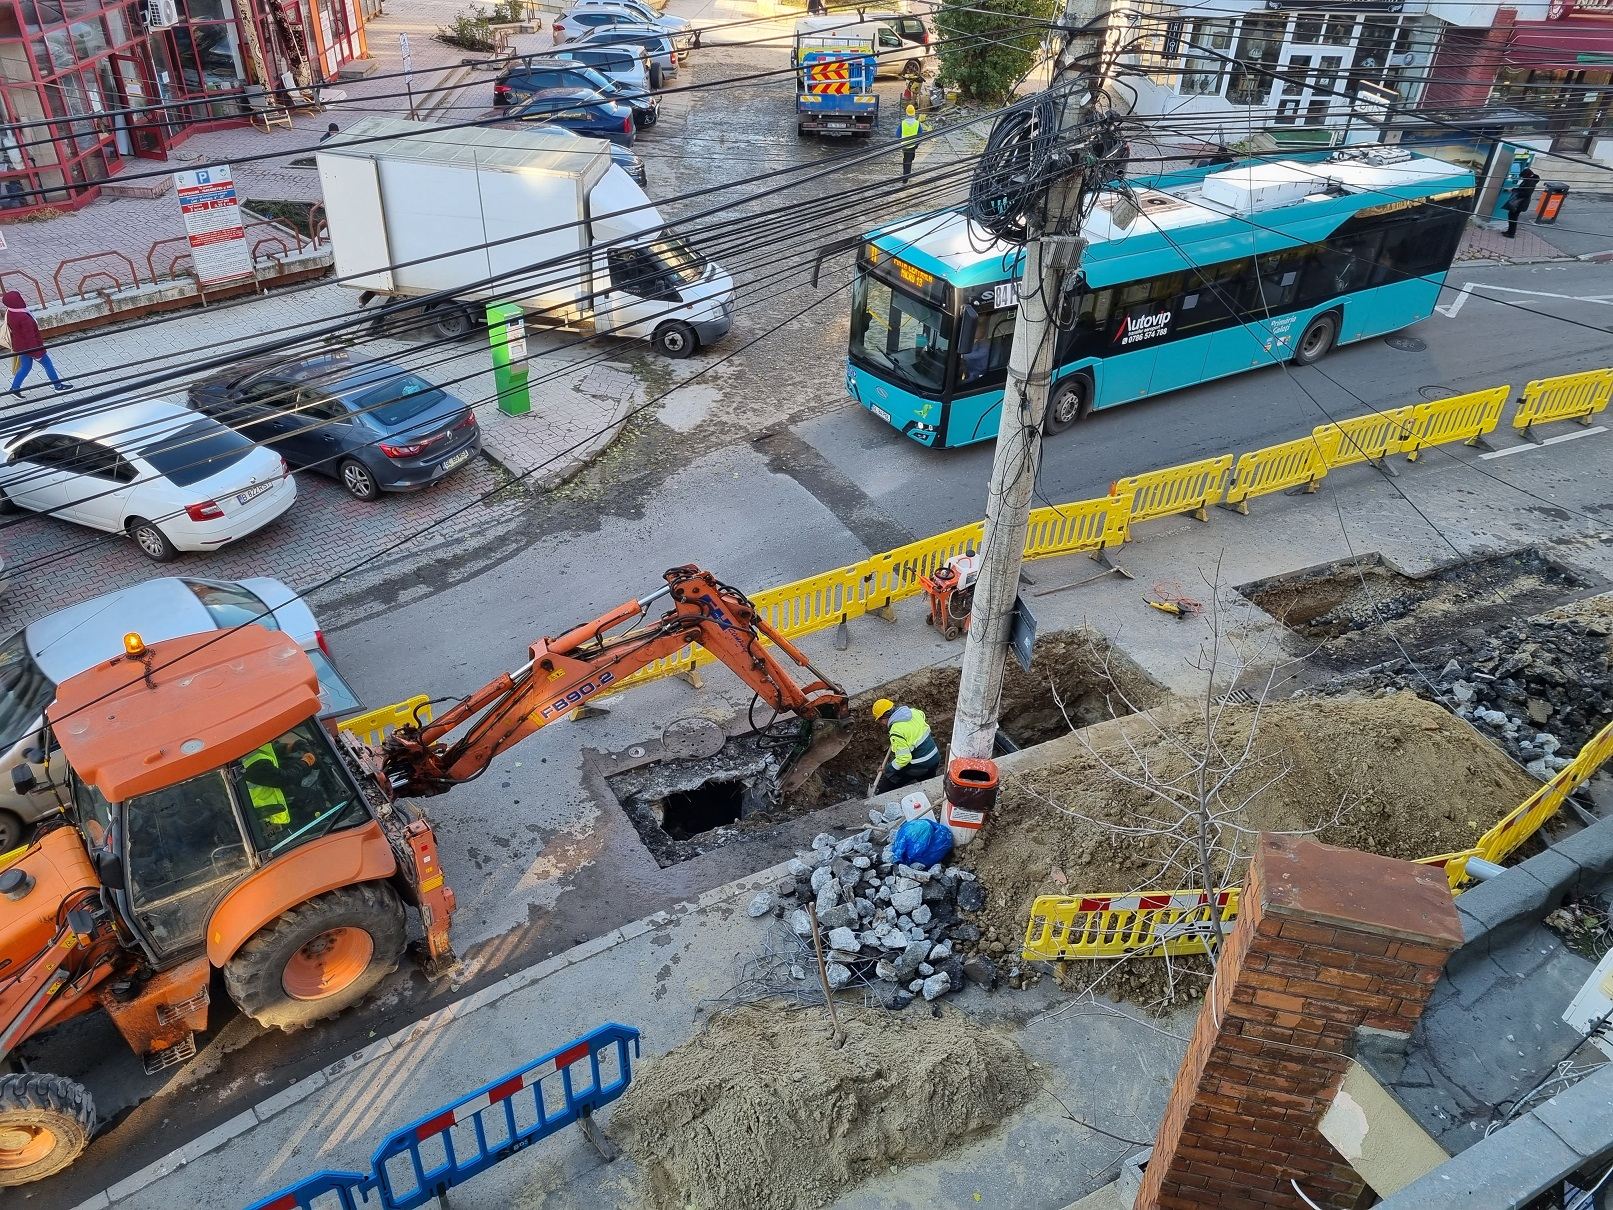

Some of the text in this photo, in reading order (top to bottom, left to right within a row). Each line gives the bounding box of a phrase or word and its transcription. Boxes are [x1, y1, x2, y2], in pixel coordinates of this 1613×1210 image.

[198, 172, 208, 183] P
[995, 286, 1008, 308] 84
[1113, 309, 1171, 343] Autovip
[1144, 331, 1156, 340] 574
[540, 671, 616, 719] FB90.2
